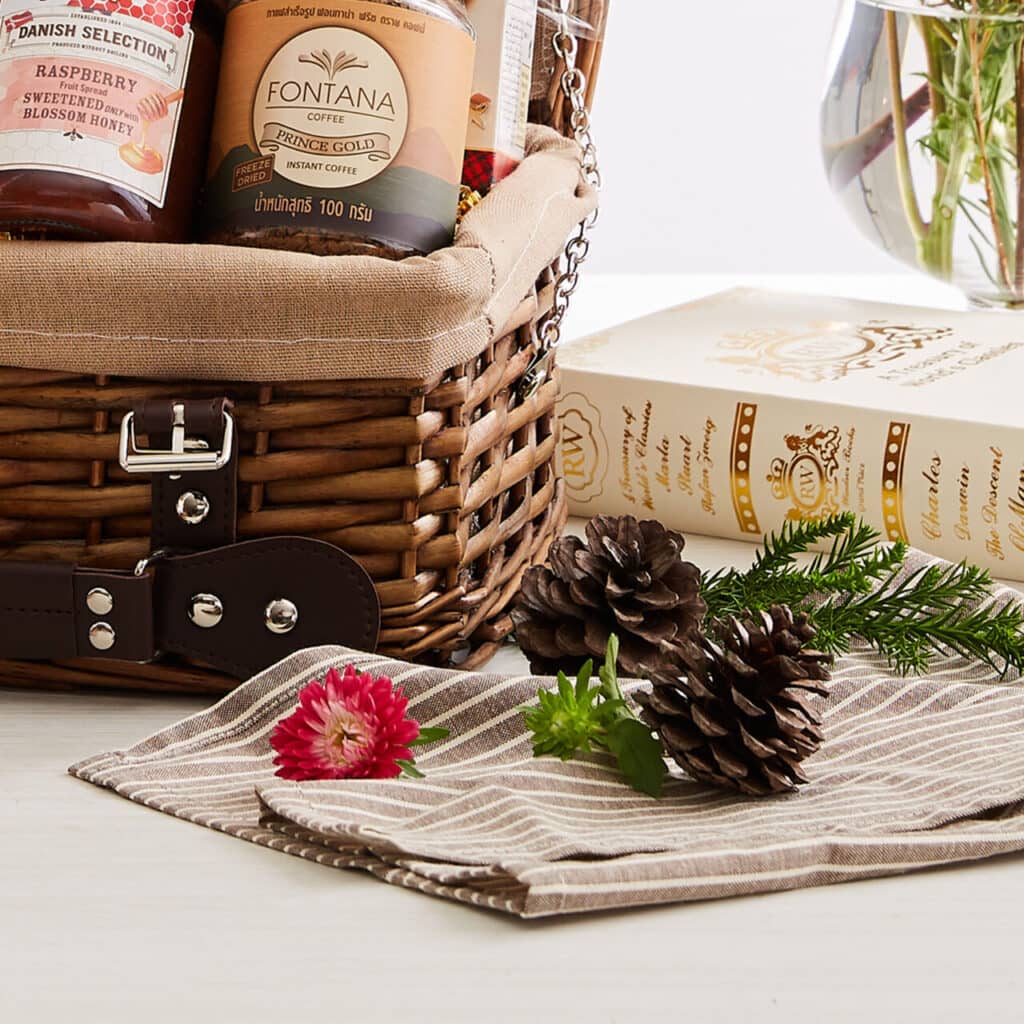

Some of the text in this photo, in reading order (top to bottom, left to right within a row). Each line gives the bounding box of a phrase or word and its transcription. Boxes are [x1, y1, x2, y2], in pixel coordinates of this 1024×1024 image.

[18, 23, 167, 63] DANISH SELECTION
[36, 64, 138, 93] RASPBERRY
[59, 80, 108, 97] Fruit Spread
[23, 92, 104, 111] SWEETENED
[105, 104, 124, 117] ONLY
[267, 80, 395, 115] FONTANA
[23, 107, 135, 137] BLOSSOM HONEY
[307, 112, 345, 124] COFFEE
[275, 129, 376, 153] PRINCE GOLD
[235, 159, 271, 176] FREEZE
[237, 171, 267, 187] DRIED
[286, 161, 358, 176] INSTANT COFFEE
[255, 192, 373, 223] น้ำหนักสุทธิ 100 กรัม
[561, 423, 585, 478] RW
[799, 464, 814, 500] RW
[921, 449, 942, 540] Charles
[953, 463, 971, 541] Darwin
[981, 446, 1005, 561] The Descent
